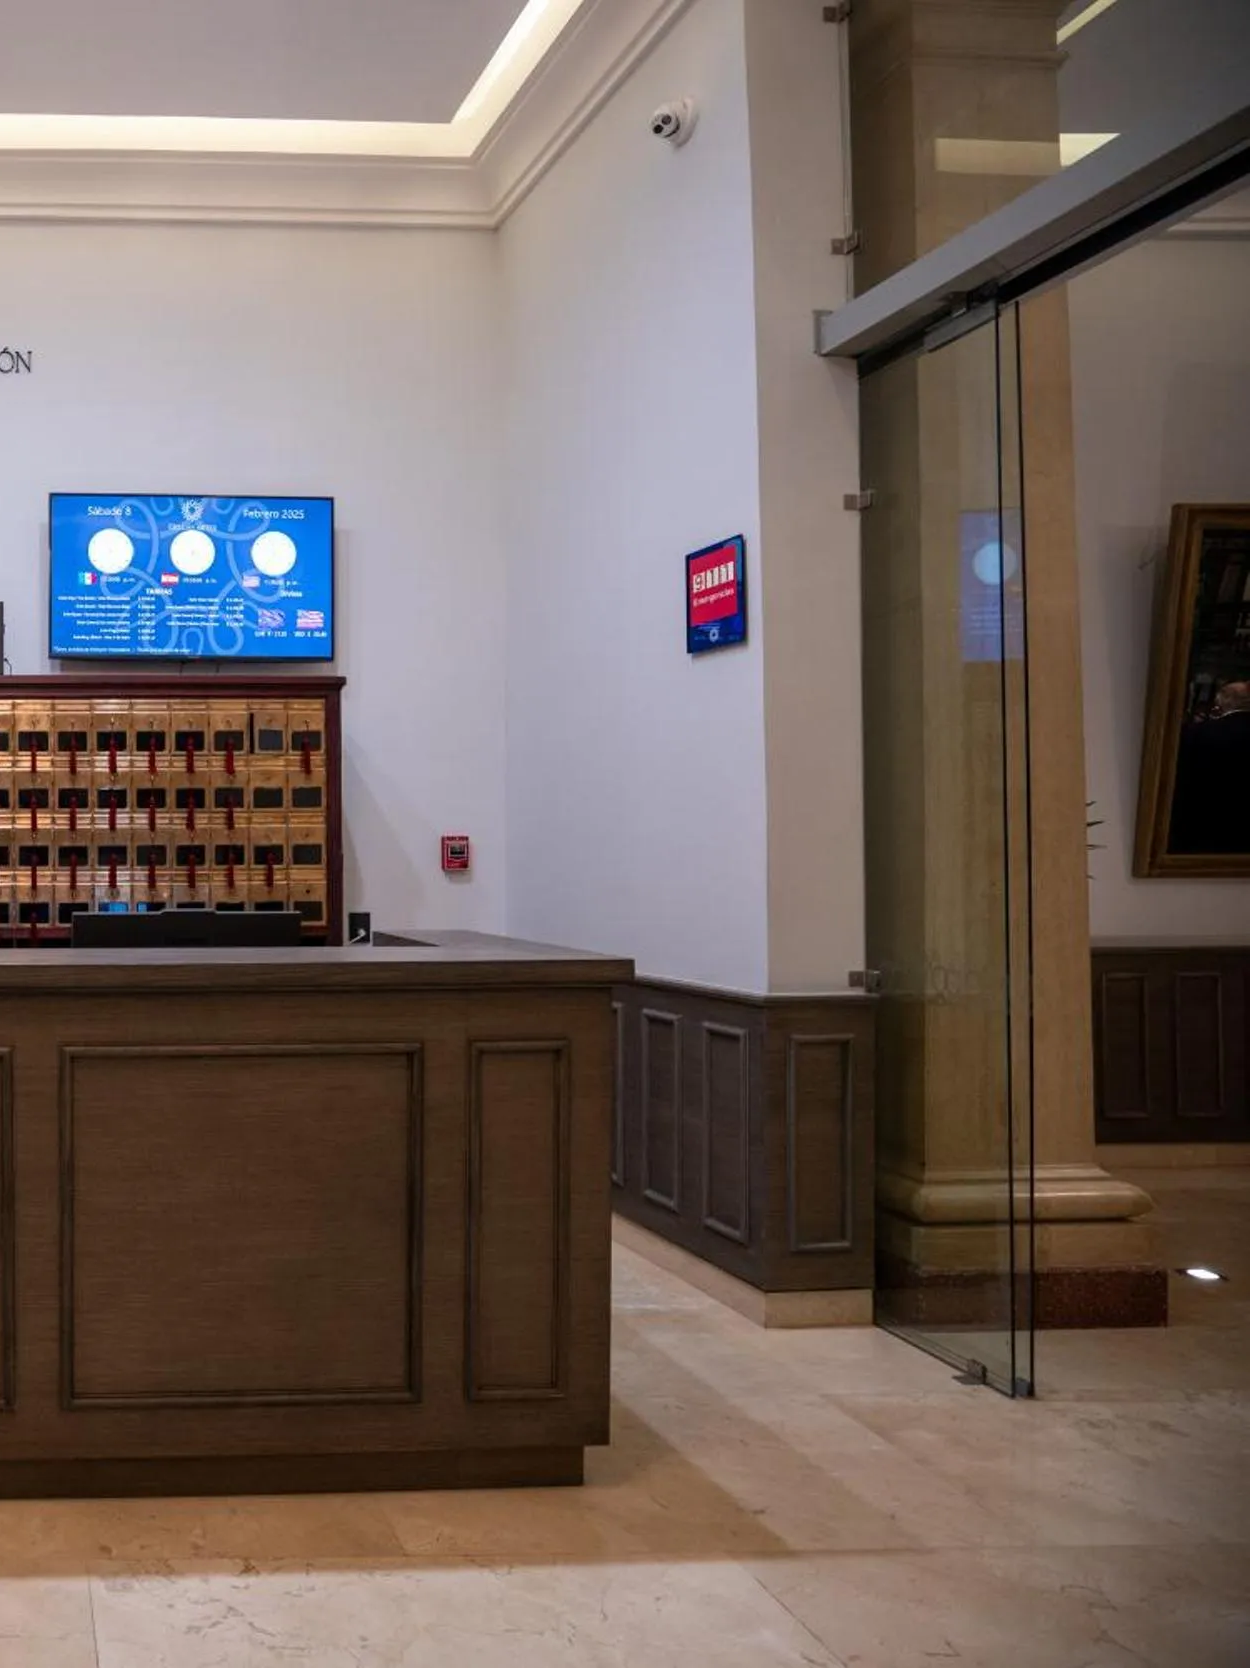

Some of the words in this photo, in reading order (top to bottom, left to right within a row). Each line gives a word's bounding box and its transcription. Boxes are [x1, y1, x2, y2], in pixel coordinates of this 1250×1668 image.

[87, 505, 122, 516] Sábado
[243, 509, 279, 519] Febrero
[281, 509, 305, 519] 2025
